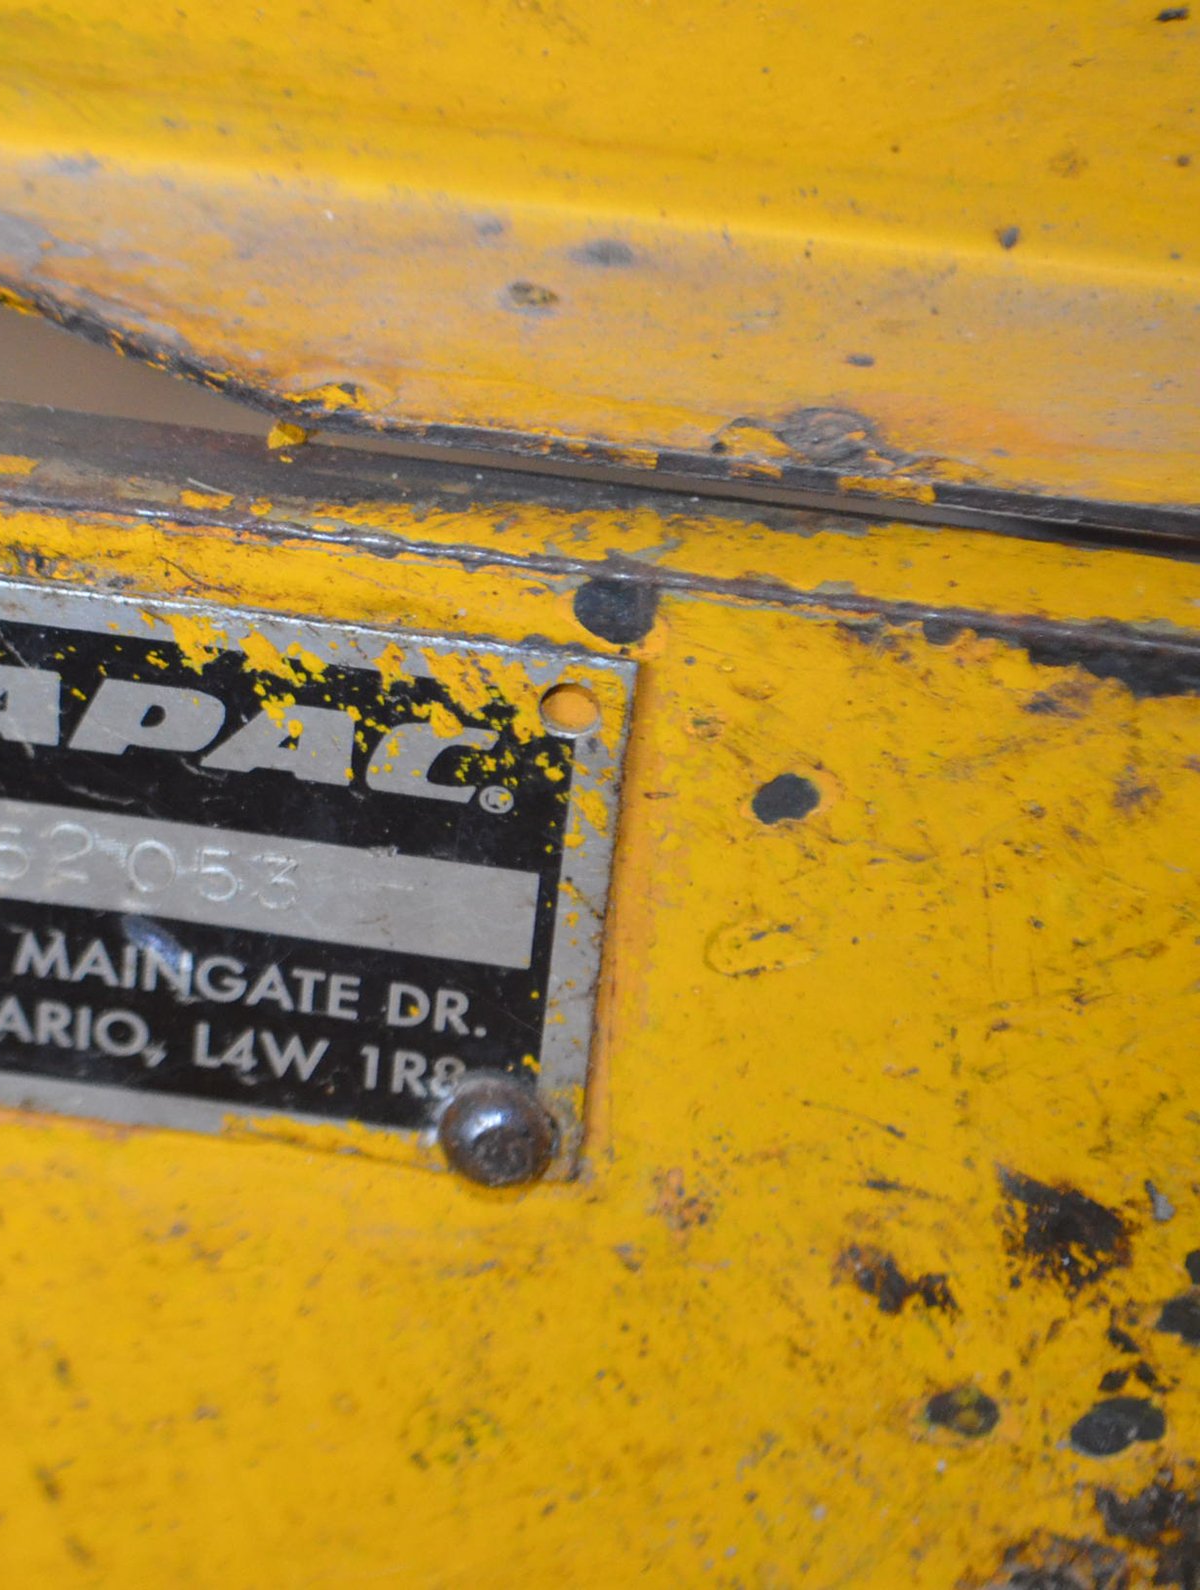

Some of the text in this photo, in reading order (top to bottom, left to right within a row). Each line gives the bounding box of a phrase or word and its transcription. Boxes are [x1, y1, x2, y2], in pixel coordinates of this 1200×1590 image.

[12, 927, 361, 1022] MAINGATE
[386, 982, 488, 1038] DR.
[193, 1020, 330, 1083] L4W
[360, 1044, 468, 1100] 1R8
